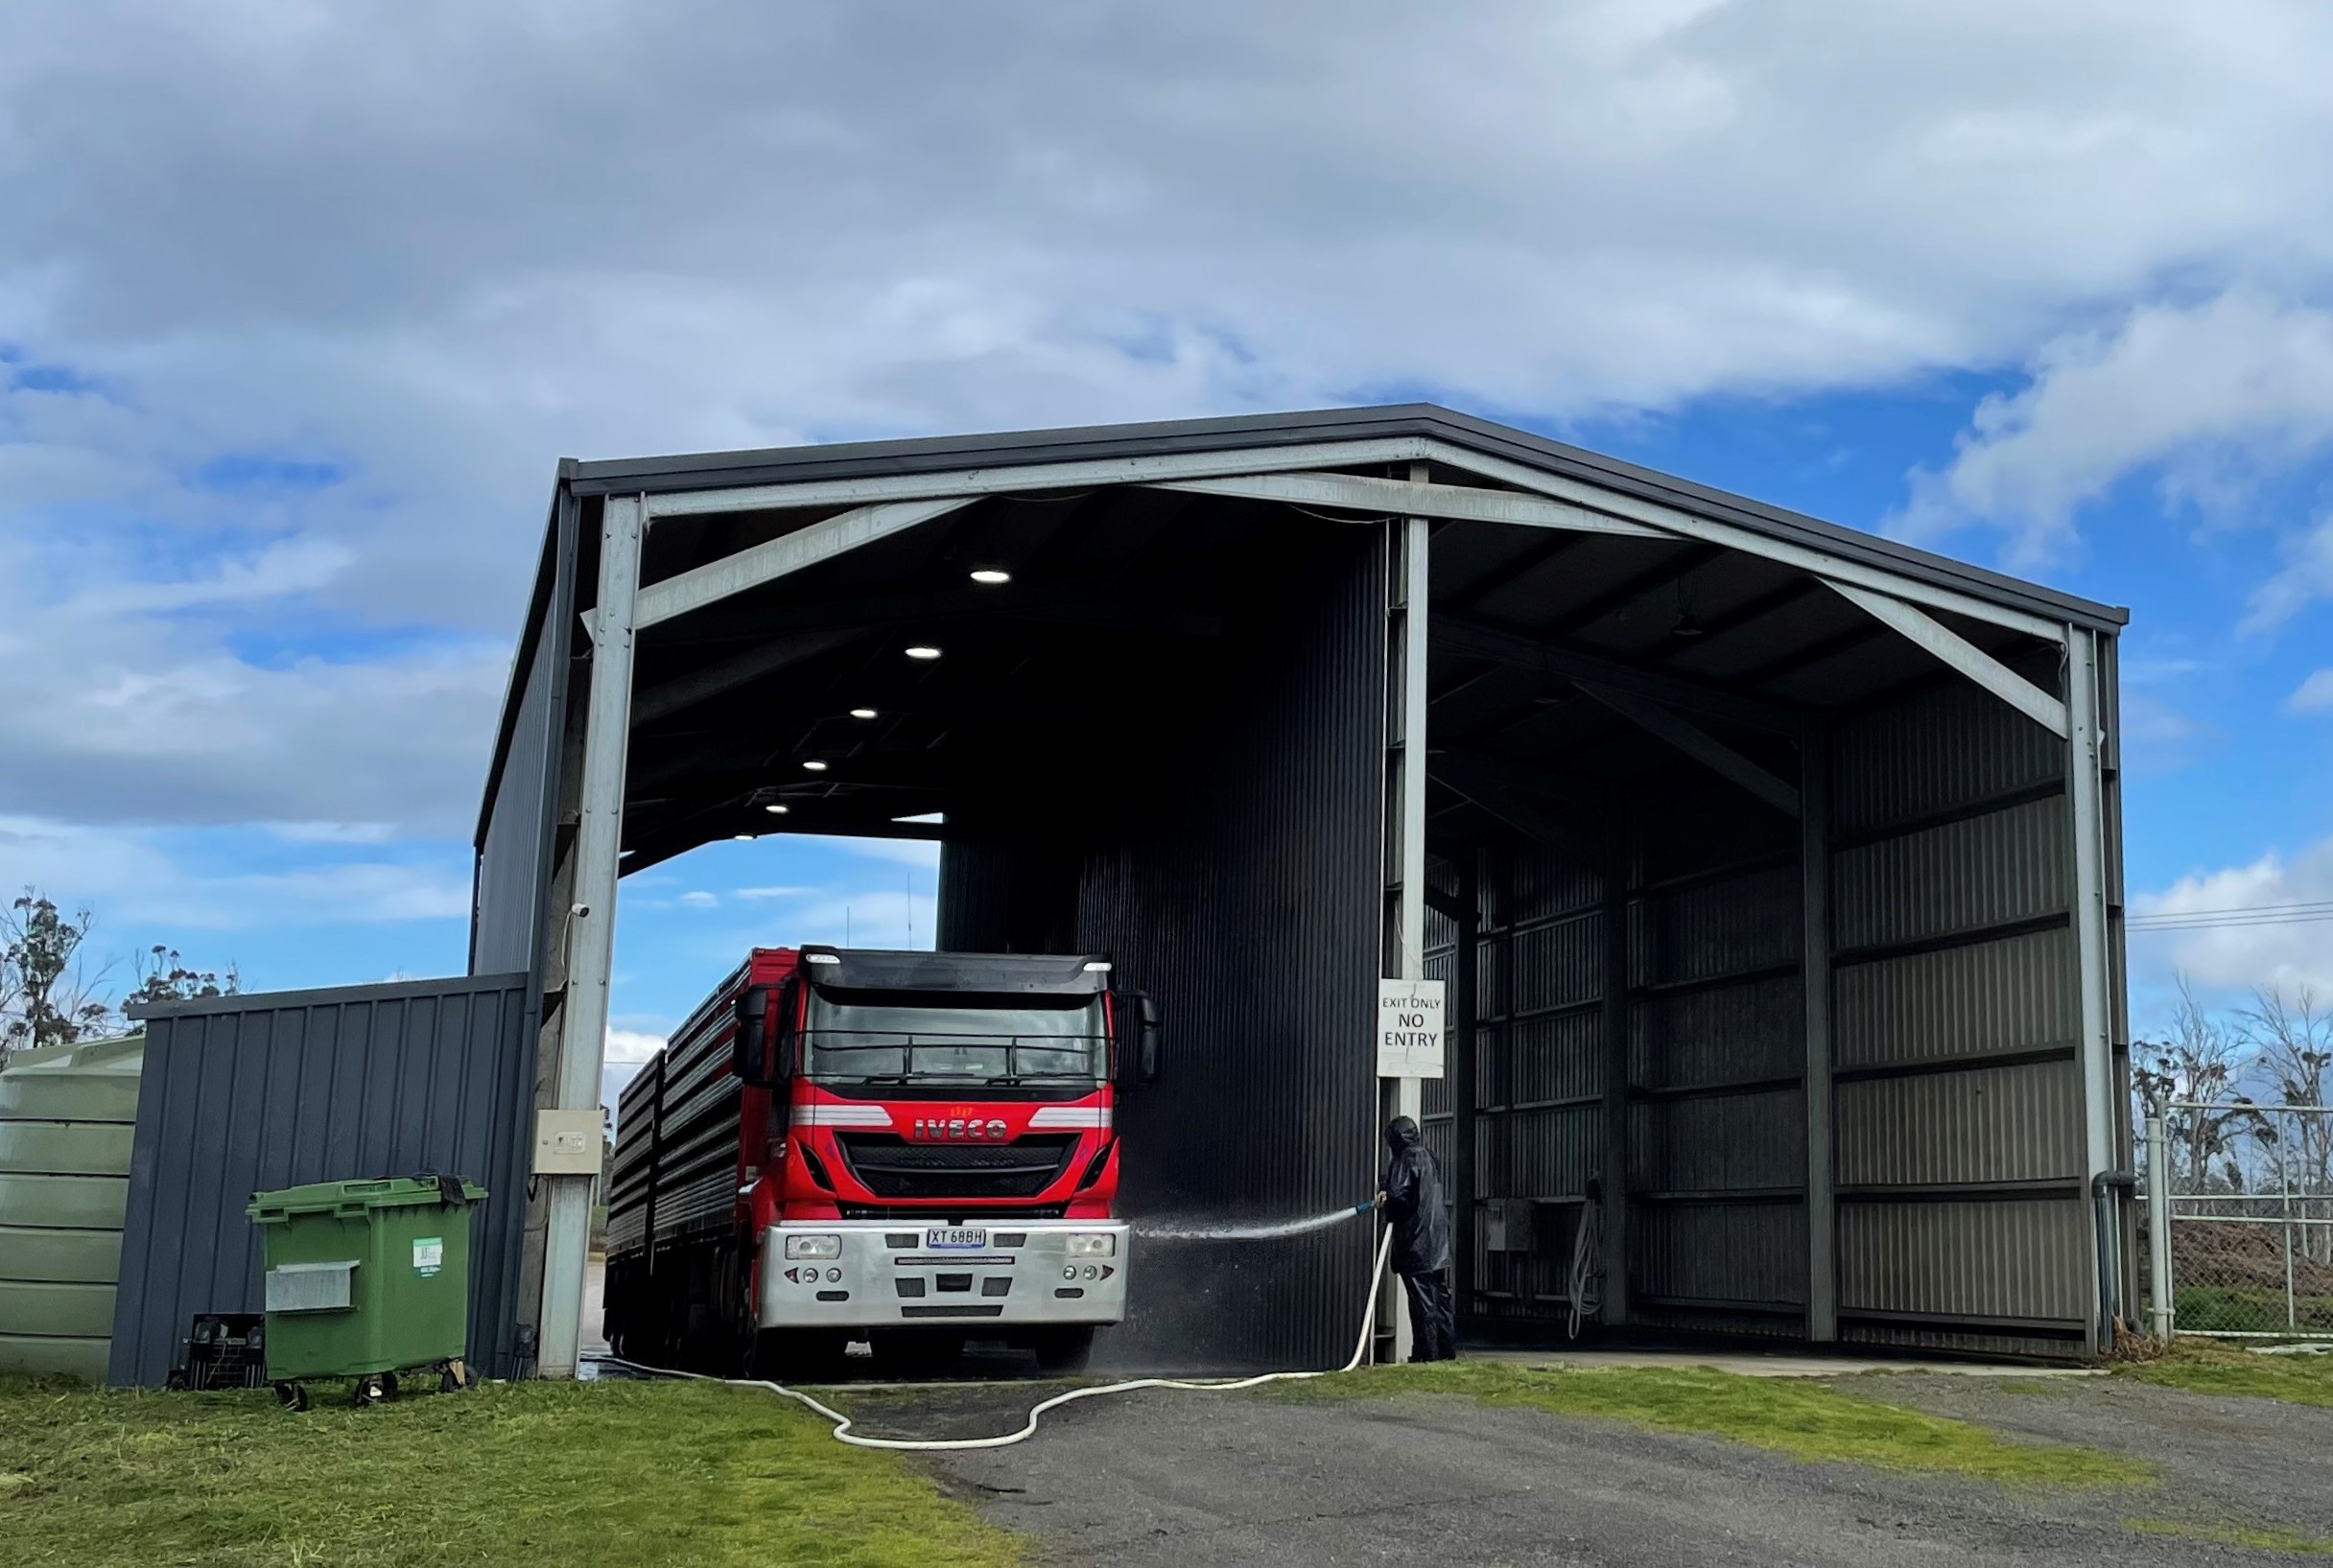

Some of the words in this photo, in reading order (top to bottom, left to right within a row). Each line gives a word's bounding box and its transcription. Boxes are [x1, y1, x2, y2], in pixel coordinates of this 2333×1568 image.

[1382, 997, 1407, 1008] EXIT
[1410, 998, 1441, 1009] ONLY
[1399, 1014, 1425, 1028] NO
[1384, 1031, 1438, 1047] ENTRY
[914, 1119, 1007, 1138] IVECO
[931, 1230, 948, 1243] XT
